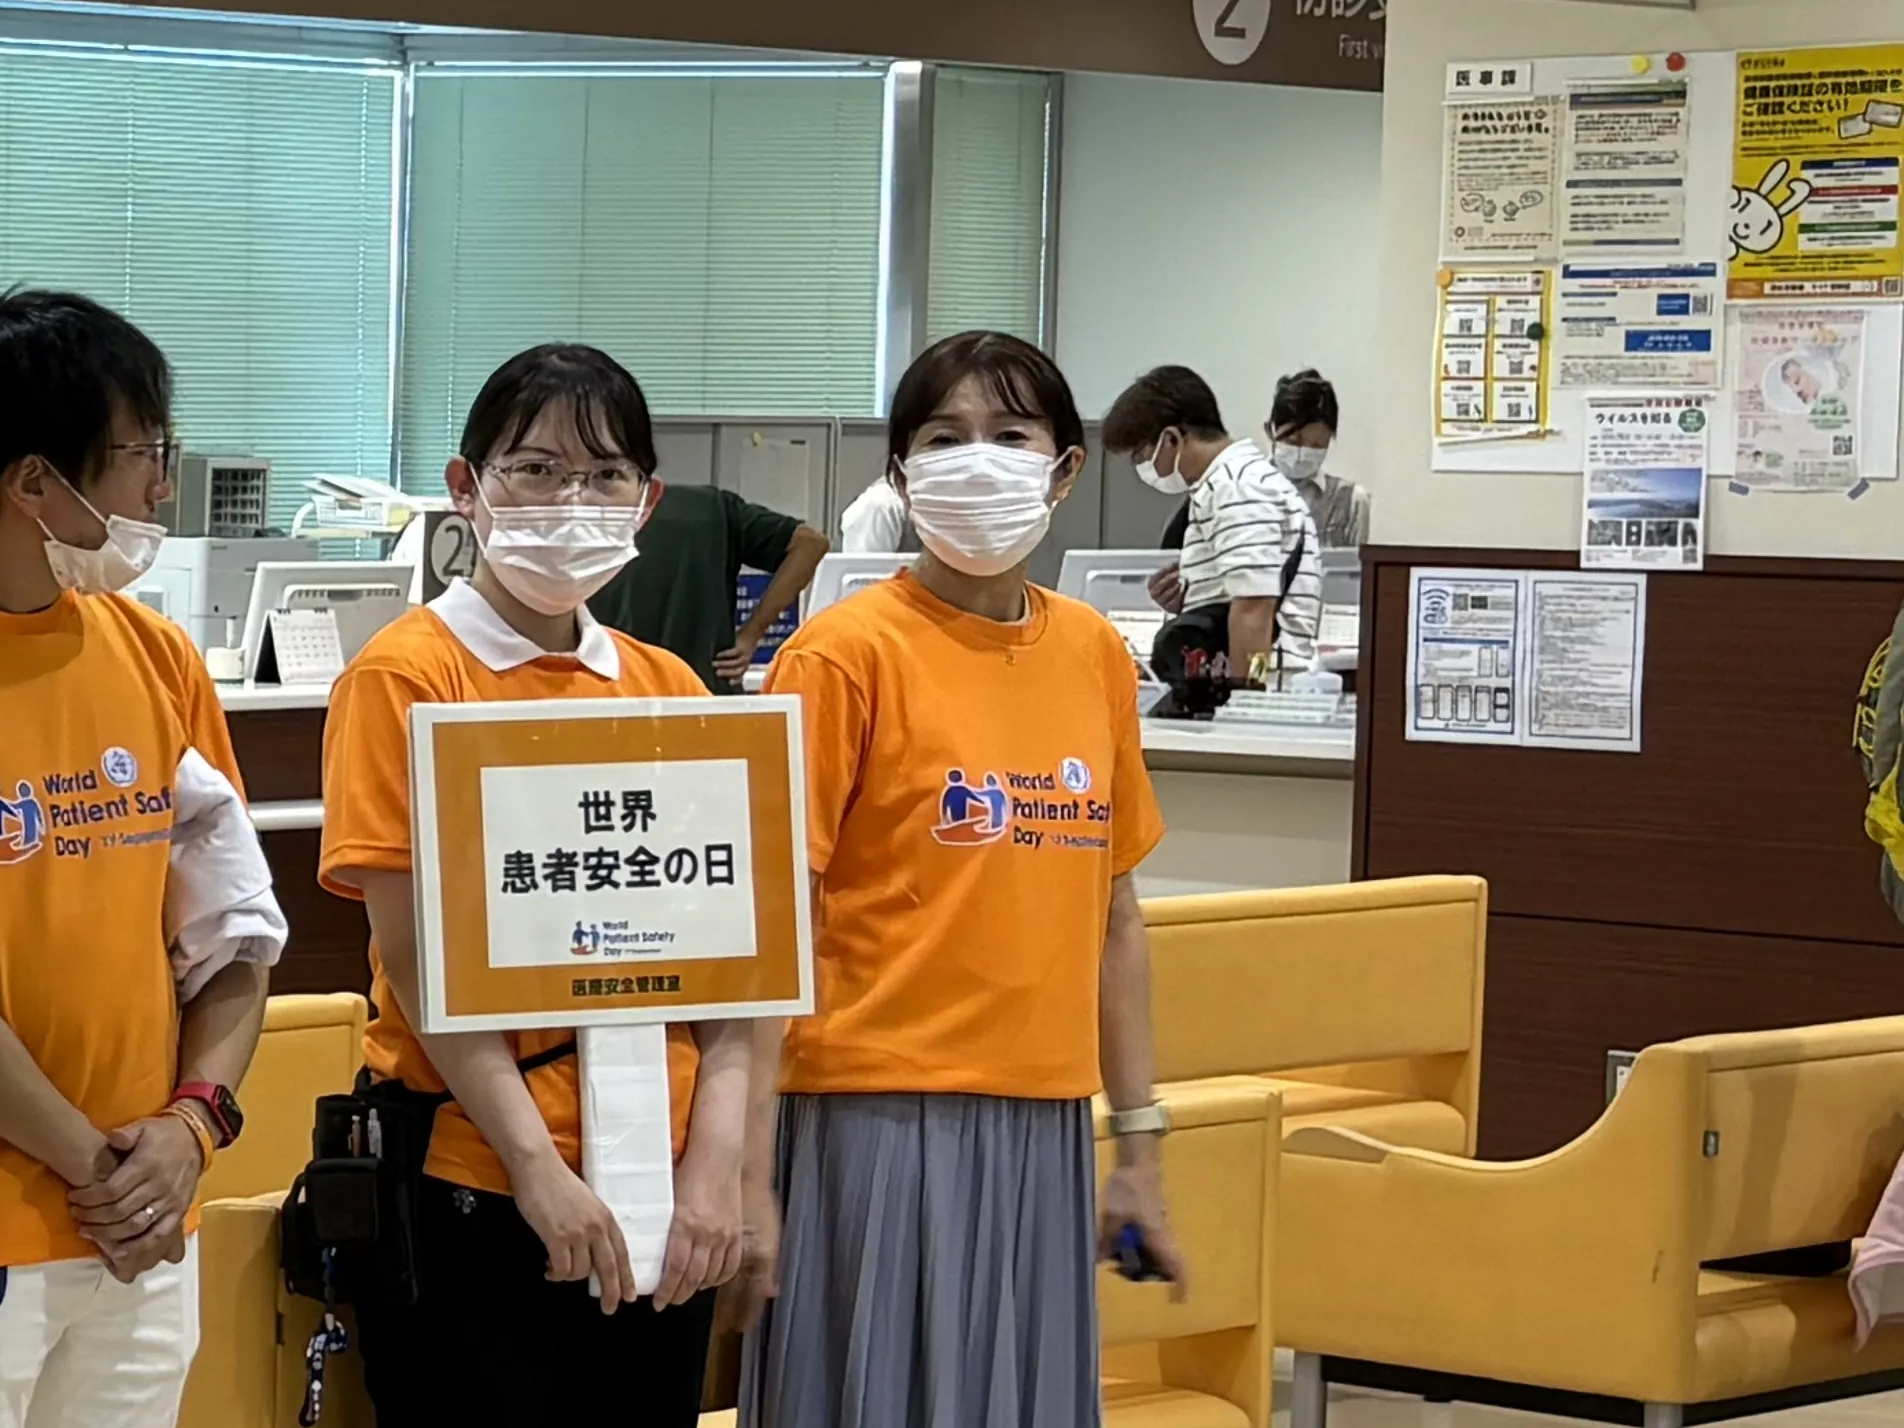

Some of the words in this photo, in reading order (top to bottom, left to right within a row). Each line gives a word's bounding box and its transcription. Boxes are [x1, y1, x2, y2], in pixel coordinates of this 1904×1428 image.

[1339, 34, 1368, 59] First
[442, 524, 465, 576] 2
[43, 769, 98, 795] World
[1005, 770, 1056, 791] World
[48, 797, 130, 829] Patient
[135, 786, 174, 822] Saf
[577, 789, 657, 834] 世界
[1012, 796, 1080, 820] Patient
[1086, 799, 1110, 822] Saf
[54, 835, 91, 859] Day
[1013, 826, 1044, 850] Day
[501, 843, 735, 894] 患者安全の日
